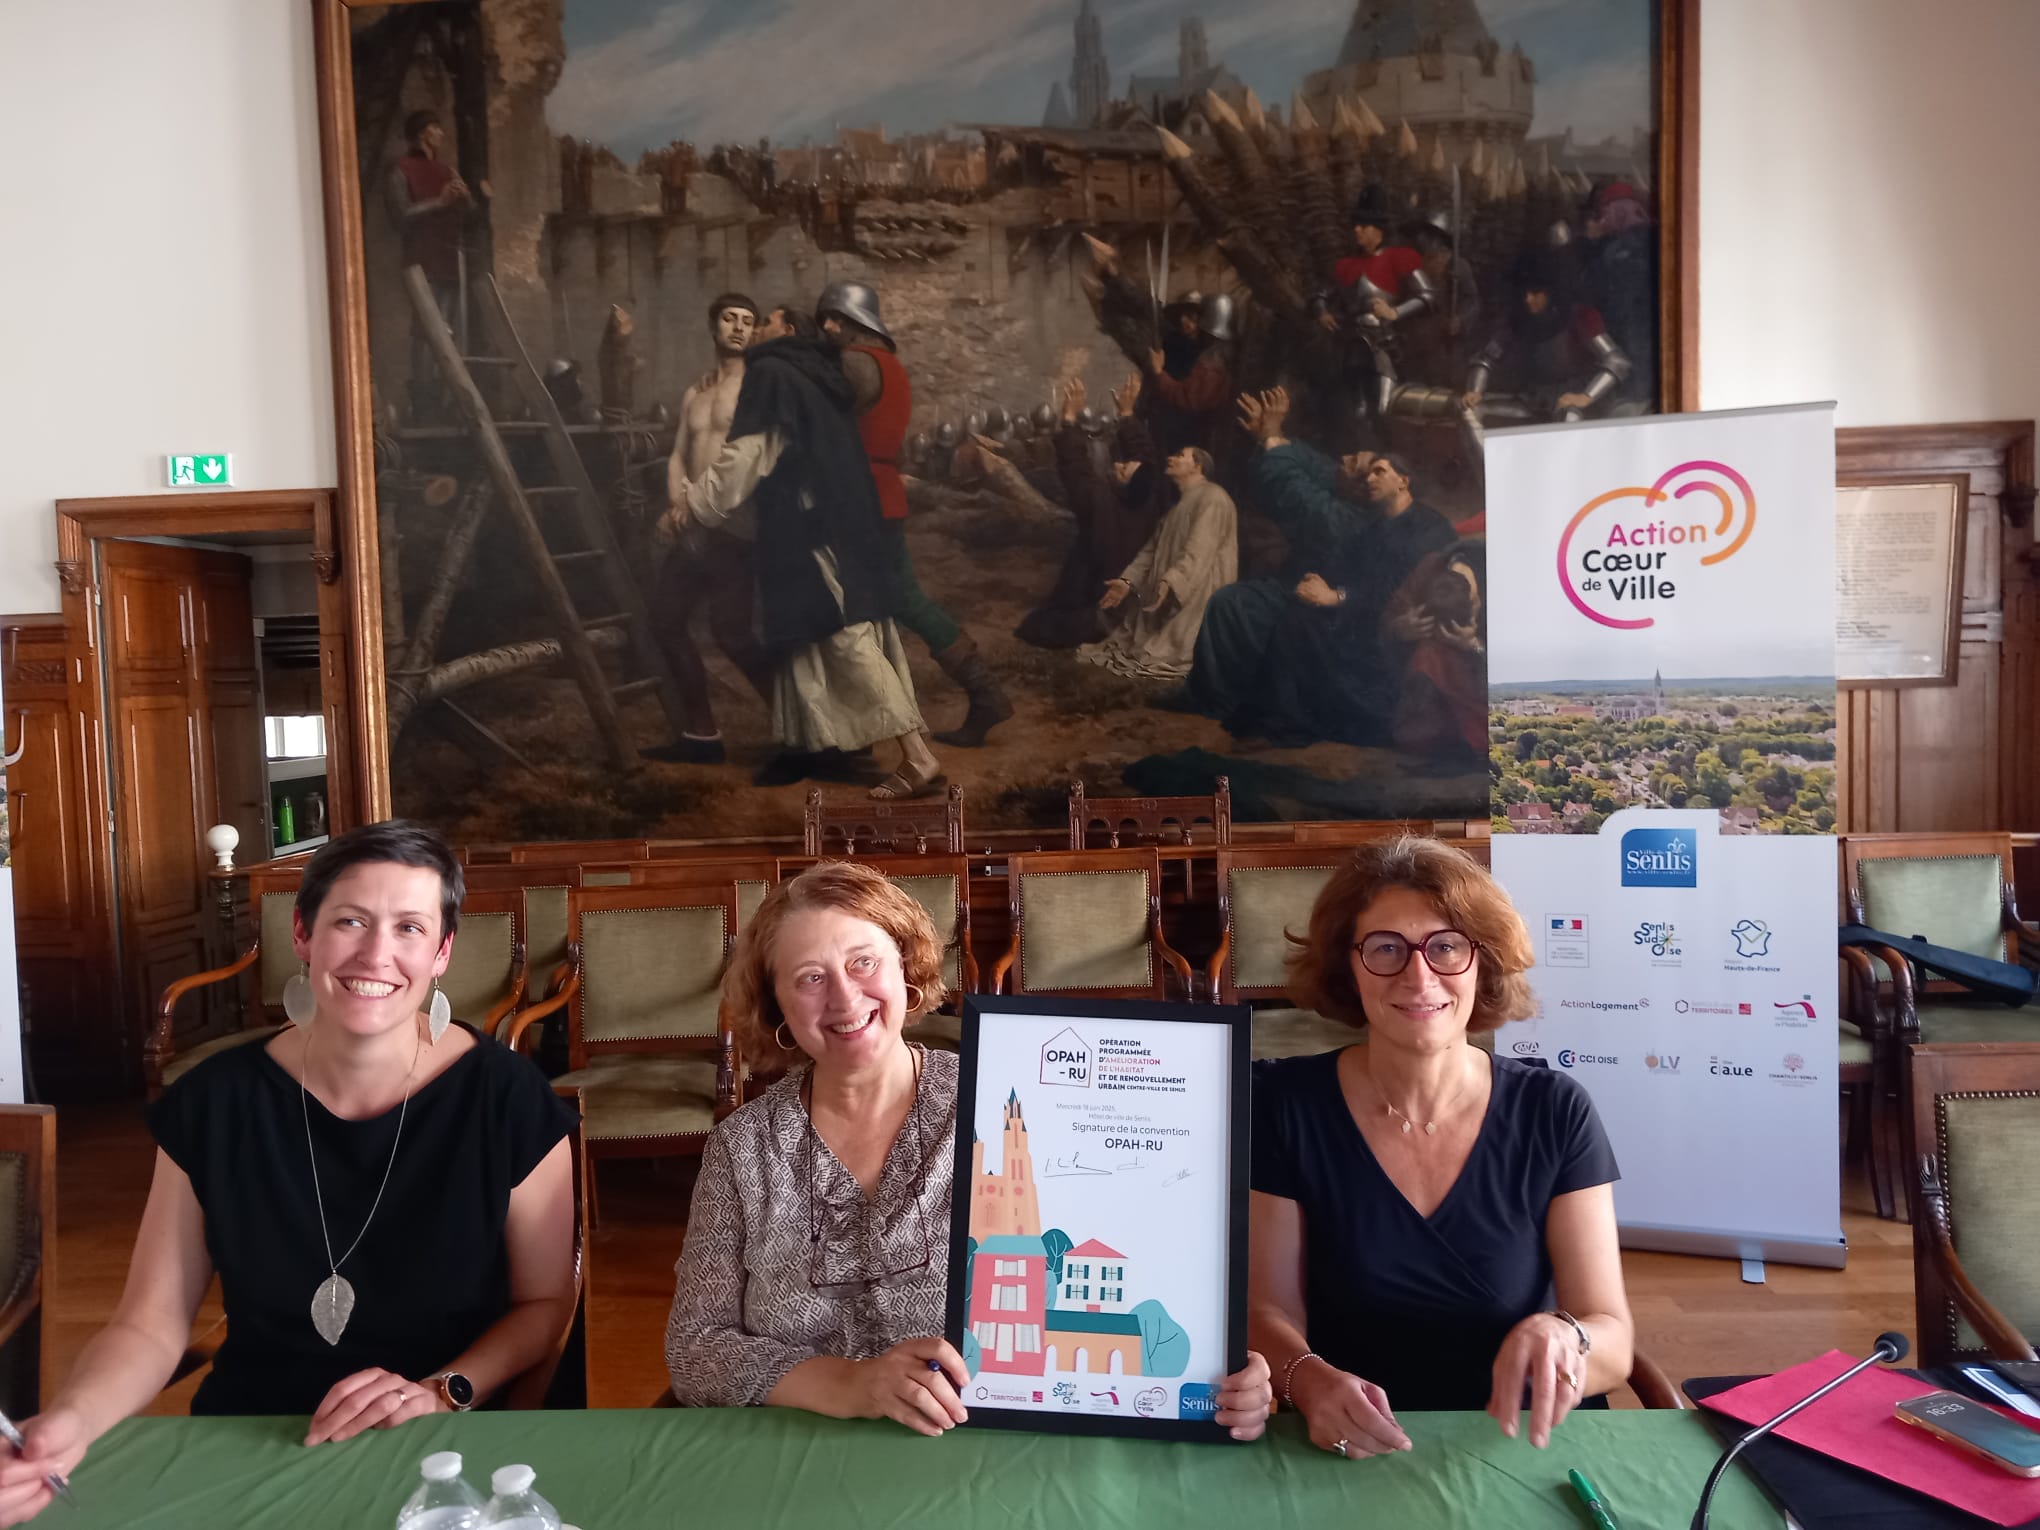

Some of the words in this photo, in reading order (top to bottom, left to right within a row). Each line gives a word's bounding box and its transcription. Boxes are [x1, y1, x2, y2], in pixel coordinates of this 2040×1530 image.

[1606, 520, 1708, 548] Action
[1582, 549, 1667, 573] Cœur
[1582, 578, 1602, 592] de
[1608, 575, 1676, 601] Ville
[1626, 850, 1691, 871] Senlis
[1634, 930, 1659, 945] Sud
[1046, 1049, 1086, 1064] OPAH
[1579, 1054, 1596, 1064] CCI
[1598, 1056, 1619, 1065] OISE
[1109, 1074, 1118, 1082] DE
[1119, 1075, 1186, 1085] RENOUVELLEMENT
[1098, 1083, 1126, 1091] URBAIN
[1072, 1122, 1116, 1133] Signature
[1116, 1124, 1129, 1133] de
[1129, 1125, 1138, 1134] la
[1139, 1126, 1190, 1136] convention
[1104, 1137, 1163, 1151] OPAH-RU
[1181, 1397, 1220, 1411] Senlis
